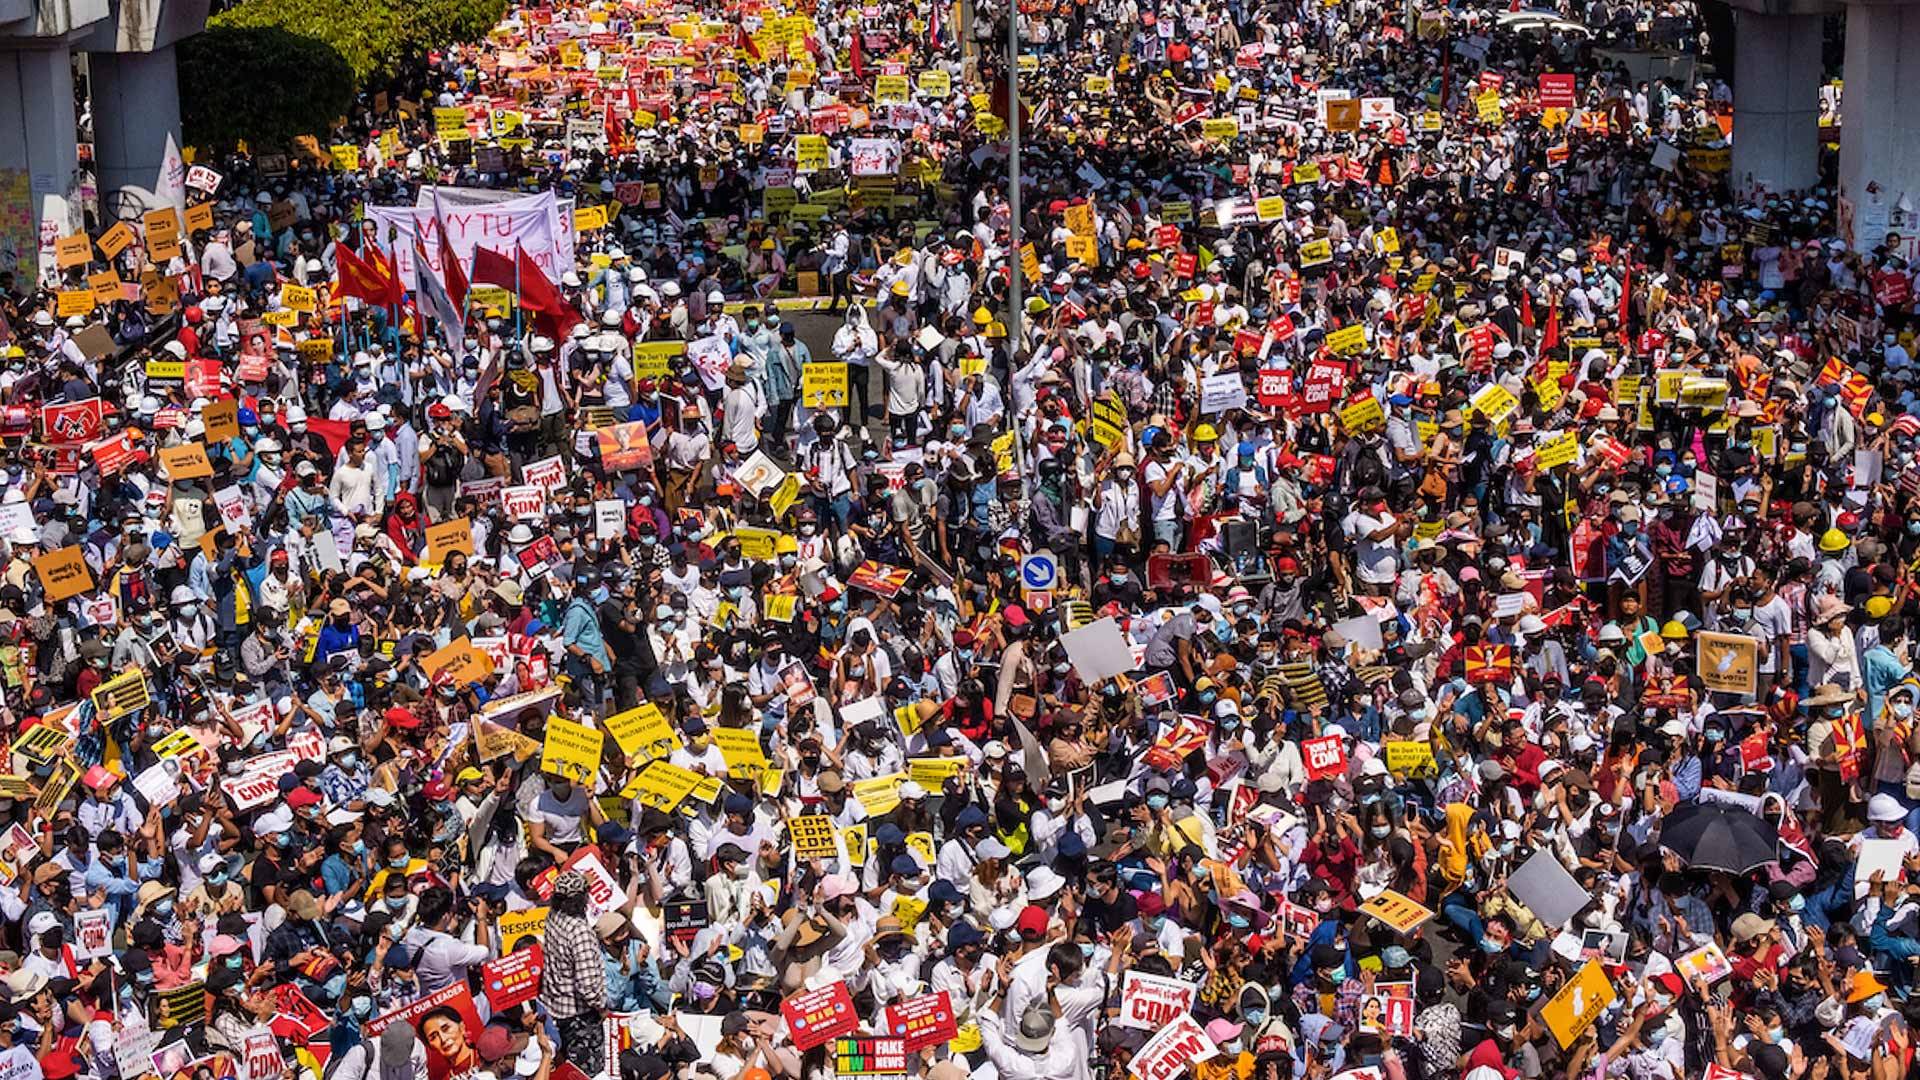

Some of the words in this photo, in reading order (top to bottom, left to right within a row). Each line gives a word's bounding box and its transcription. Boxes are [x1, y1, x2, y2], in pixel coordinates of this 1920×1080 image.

[288, 294, 309, 304] CDM
[830, 366, 846, 374] Accept
[510, 502, 541, 514] CDM
[1710, 641, 1744, 650] RESPECT
[1723, 673, 1747, 681] VOTES
[612, 722, 622, 730] We
[622, 716, 638, 728] Don't
[639, 710, 657, 721] Accept
[561, 726, 579, 737] Don't
[580, 732, 600, 744] Accept
[619, 727, 645, 740] MILITARY
[646, 720, 662, 732] COUP
[550, 736, 580, 750] MILITARY
[581, 744, 597, 755] COUP
[1217, 757, 1236, 770] WE
[644, 773, 670, 786] MILITARY
[670, 781, 687, 791] COUP
[678, 774, 695, 784] Accept
[238, 780, 279, 801] CDM
[790, 818, 828, 827] CDM
[793, 828, 830, 836] CDM
[796, 837, 834, 848] CDM
[501, 920, 545, 934] RESPEC
[84, 928, 104, 950] CDM
[1556, 972, 1584, 1003] RESPECT
[370, 1019, 387, 1032] WE
[388, 1010, 412, 1027] WANT
[414, 1001, 433, 1014] OUR
[433, 984, 465, 1005] LEADER
[1131, 998, 1182, 1026] CDM
[1569, 1017, 1583, 1034] OUR
[1584, 998, 1605, 1019] VOTES
[838, 1040, 873, 1054] MRTV
[875, 1040, 904, 1054] FAKE
[838, 1056, 873, 1072] MWD
[875, 1056, 905, 1069] NEWS
[1151, 1035, 1205, 1080] CDM
[250, 1052, 284, 1080] CDM
